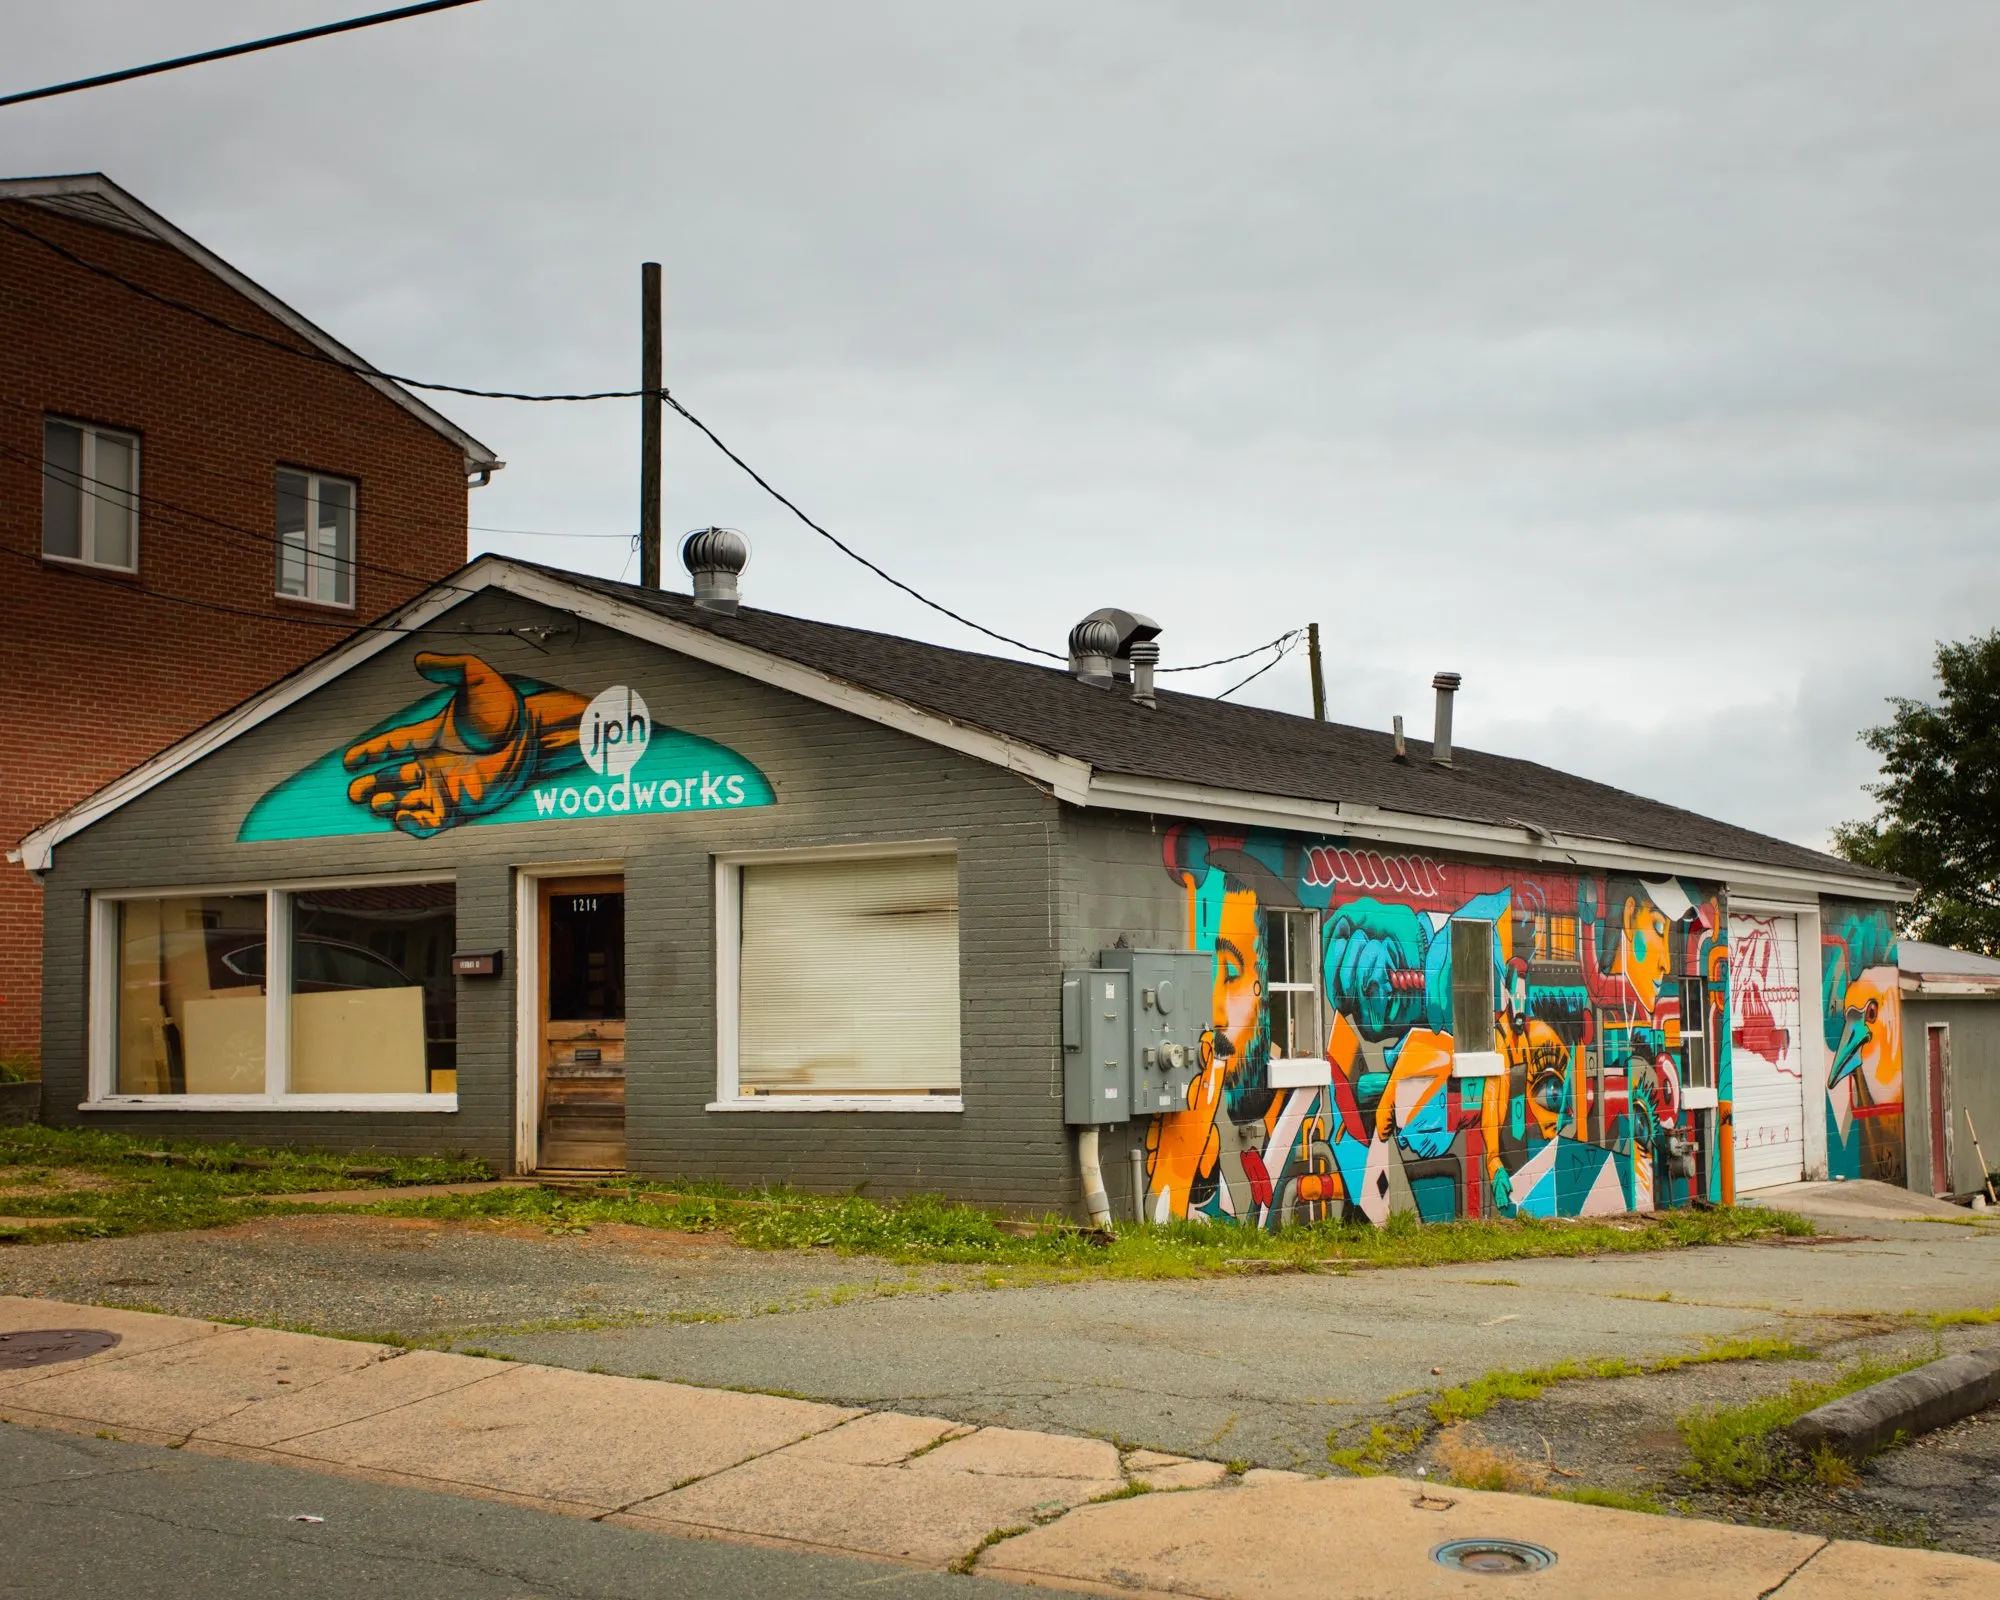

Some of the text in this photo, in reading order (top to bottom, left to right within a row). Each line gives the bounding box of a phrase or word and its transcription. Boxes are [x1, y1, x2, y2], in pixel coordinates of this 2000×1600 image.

[589, 687, 646, 774] jph
[534, 769, 745, 816] woodworks
[573, 898, 597, 912] 1214
